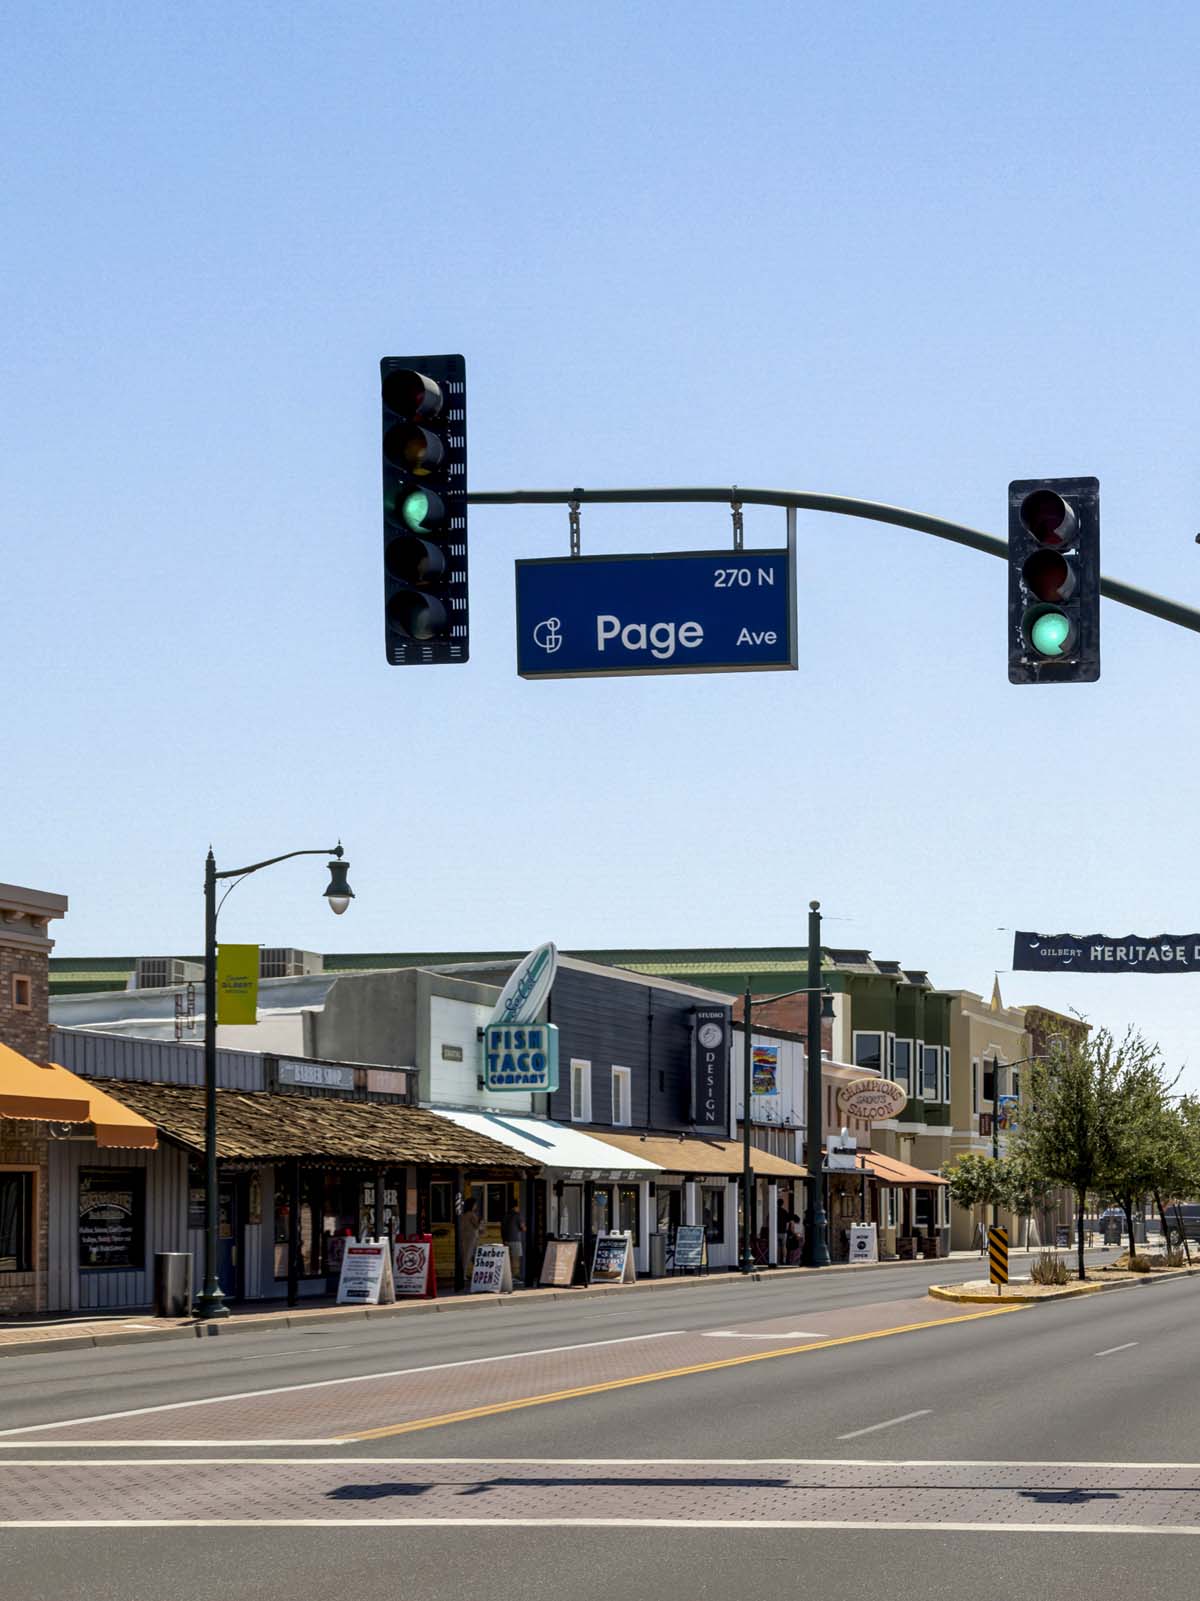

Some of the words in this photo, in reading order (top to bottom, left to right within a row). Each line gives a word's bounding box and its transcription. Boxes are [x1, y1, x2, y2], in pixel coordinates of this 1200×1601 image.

[714, 568, 751, 588] 270
[758, 567, 774, 586] N
[596, 614, 704, 659] Page
[736, 627, 778, 646] Ave
[1040, 949, 1082, 957] GILBERT
[1090, 945, 1186, 962] HERITAGE
[490, 1030, 544, 1050] FISH
[488, 1052, 546, 1073] TACO
[490, 1074, 545, 1085] COMPANY
[705, 1052, 716, 1121] DESIGN
[841, 1080, 902, 1102] CHAMPIONS
[848, 1103, 894, 1118] SALOON
[477, 1247, 505, 1258] Barber
[475, 1258, 495, 1268] Shop
[473, 1270, 493, 1285] OPEN
